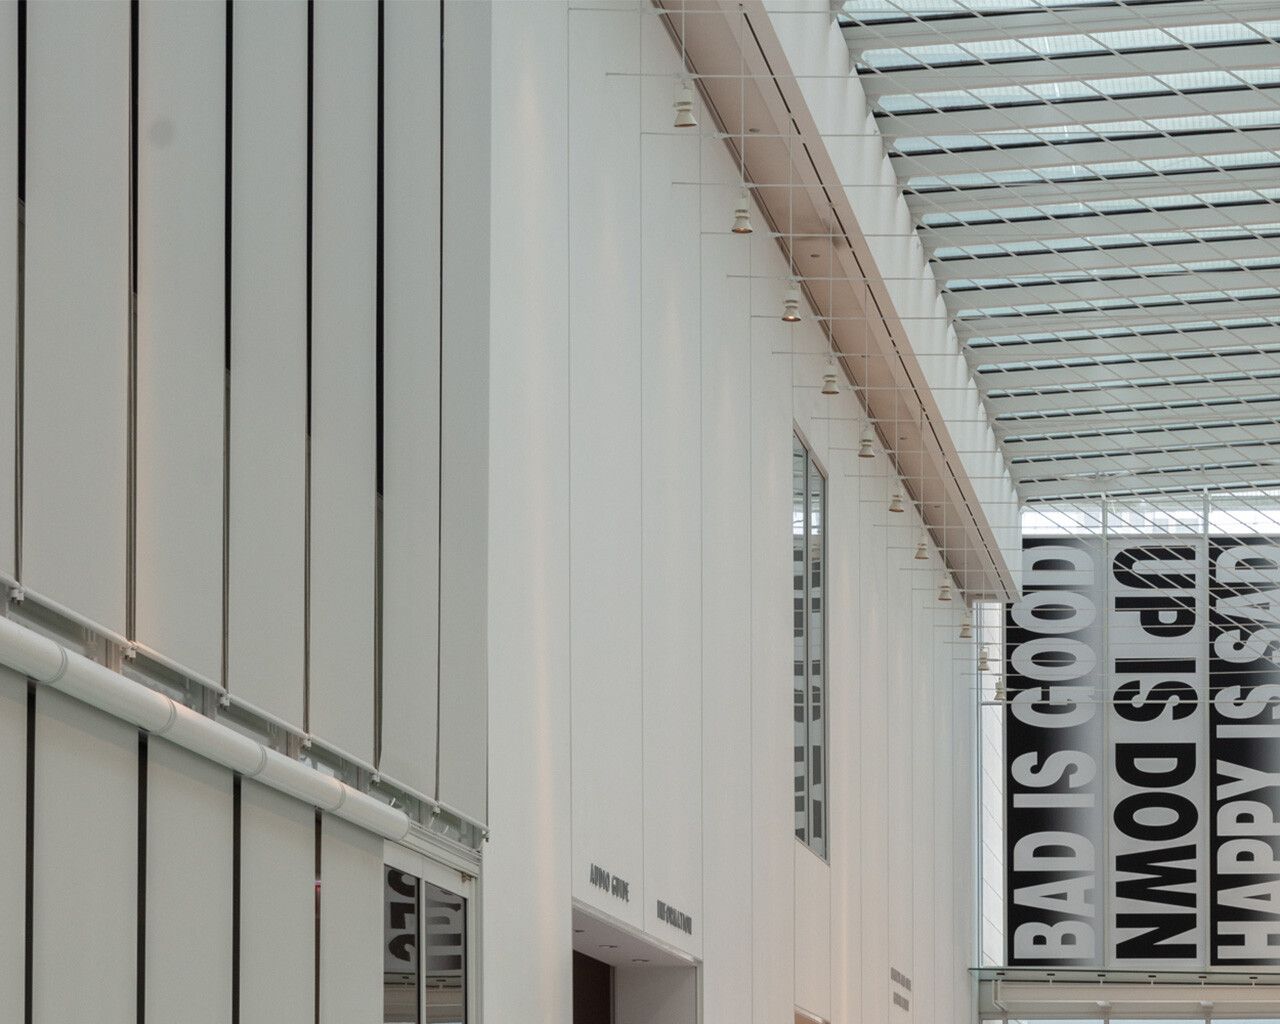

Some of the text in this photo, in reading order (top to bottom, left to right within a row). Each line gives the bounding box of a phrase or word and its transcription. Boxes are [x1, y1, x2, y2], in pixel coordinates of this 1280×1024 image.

[1011, 545, 1097, 959] BAD IS GOOD
[1112, 545, 1199, 959] UP IS DOWN
